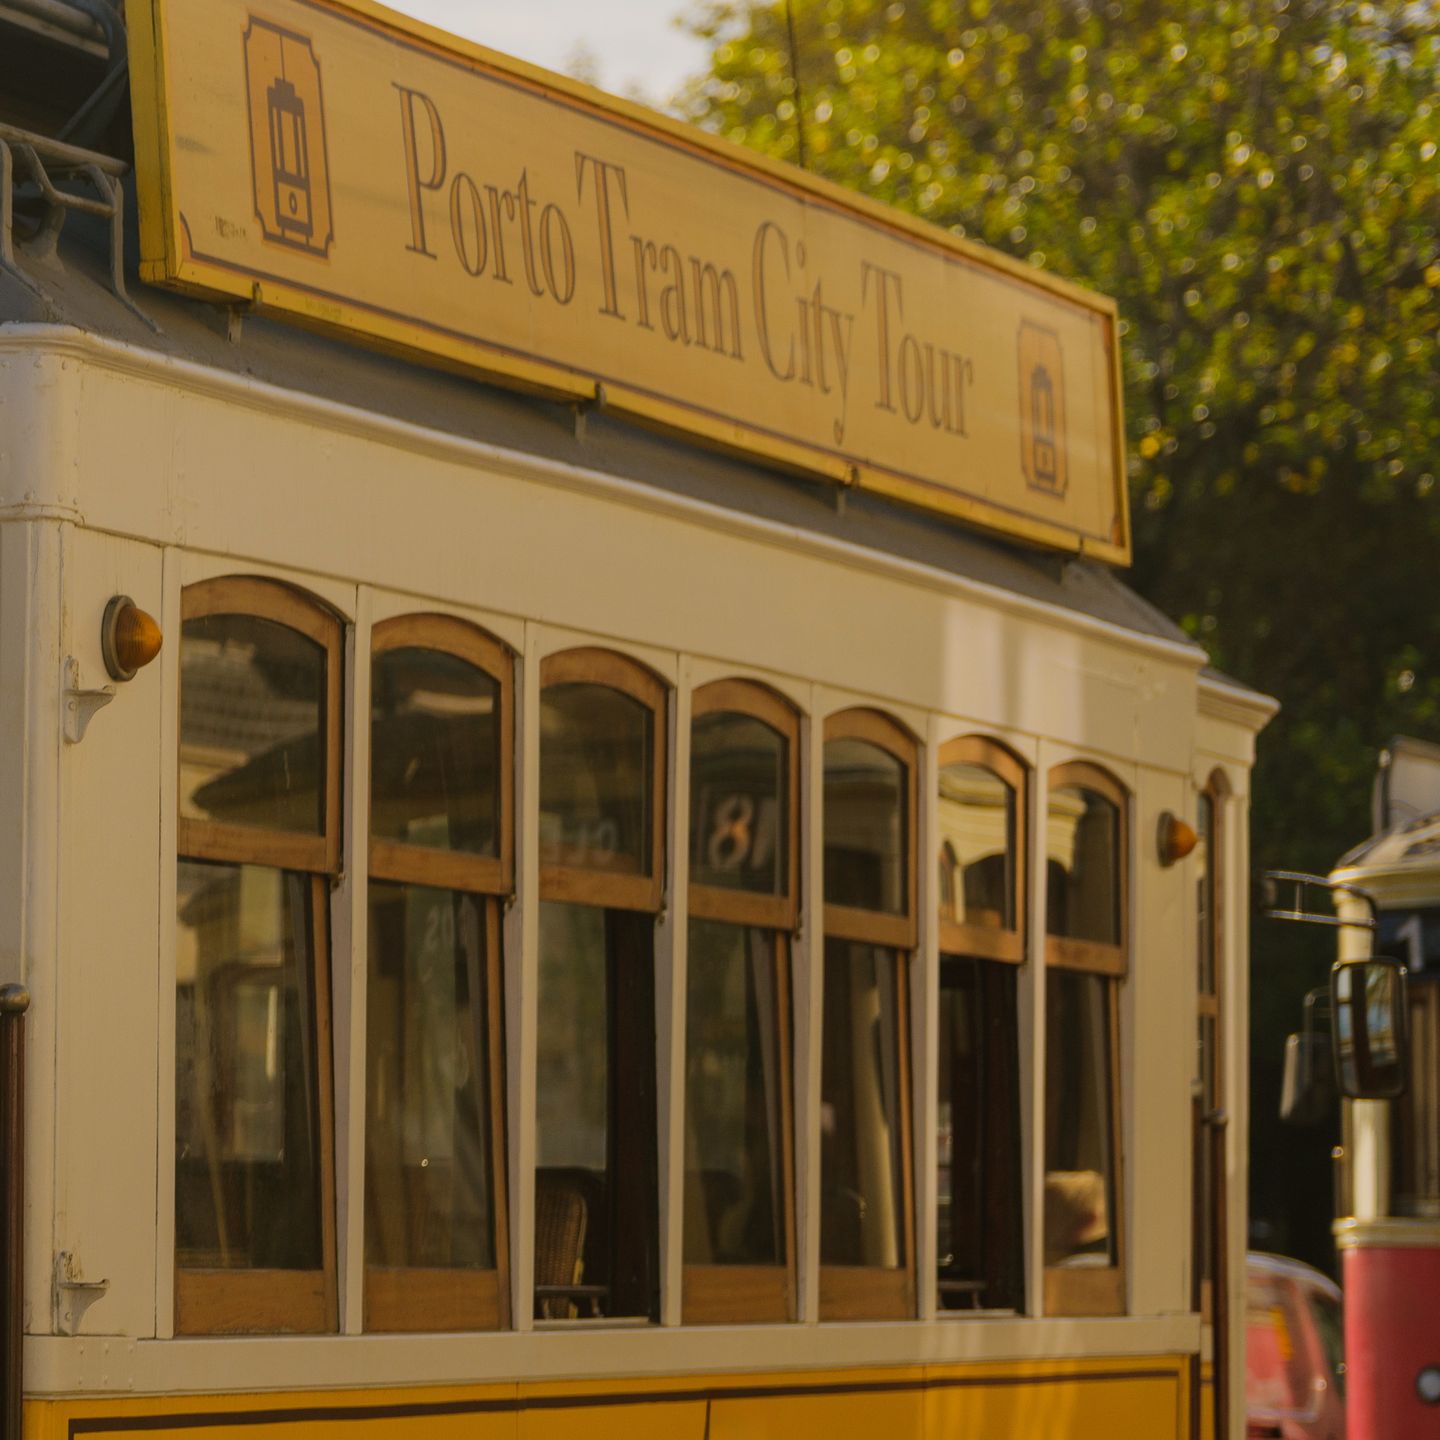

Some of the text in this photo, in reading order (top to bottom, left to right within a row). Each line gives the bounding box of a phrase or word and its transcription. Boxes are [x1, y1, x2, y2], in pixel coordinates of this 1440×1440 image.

[391, 81, 973, 446] Porto Tram City Tour
